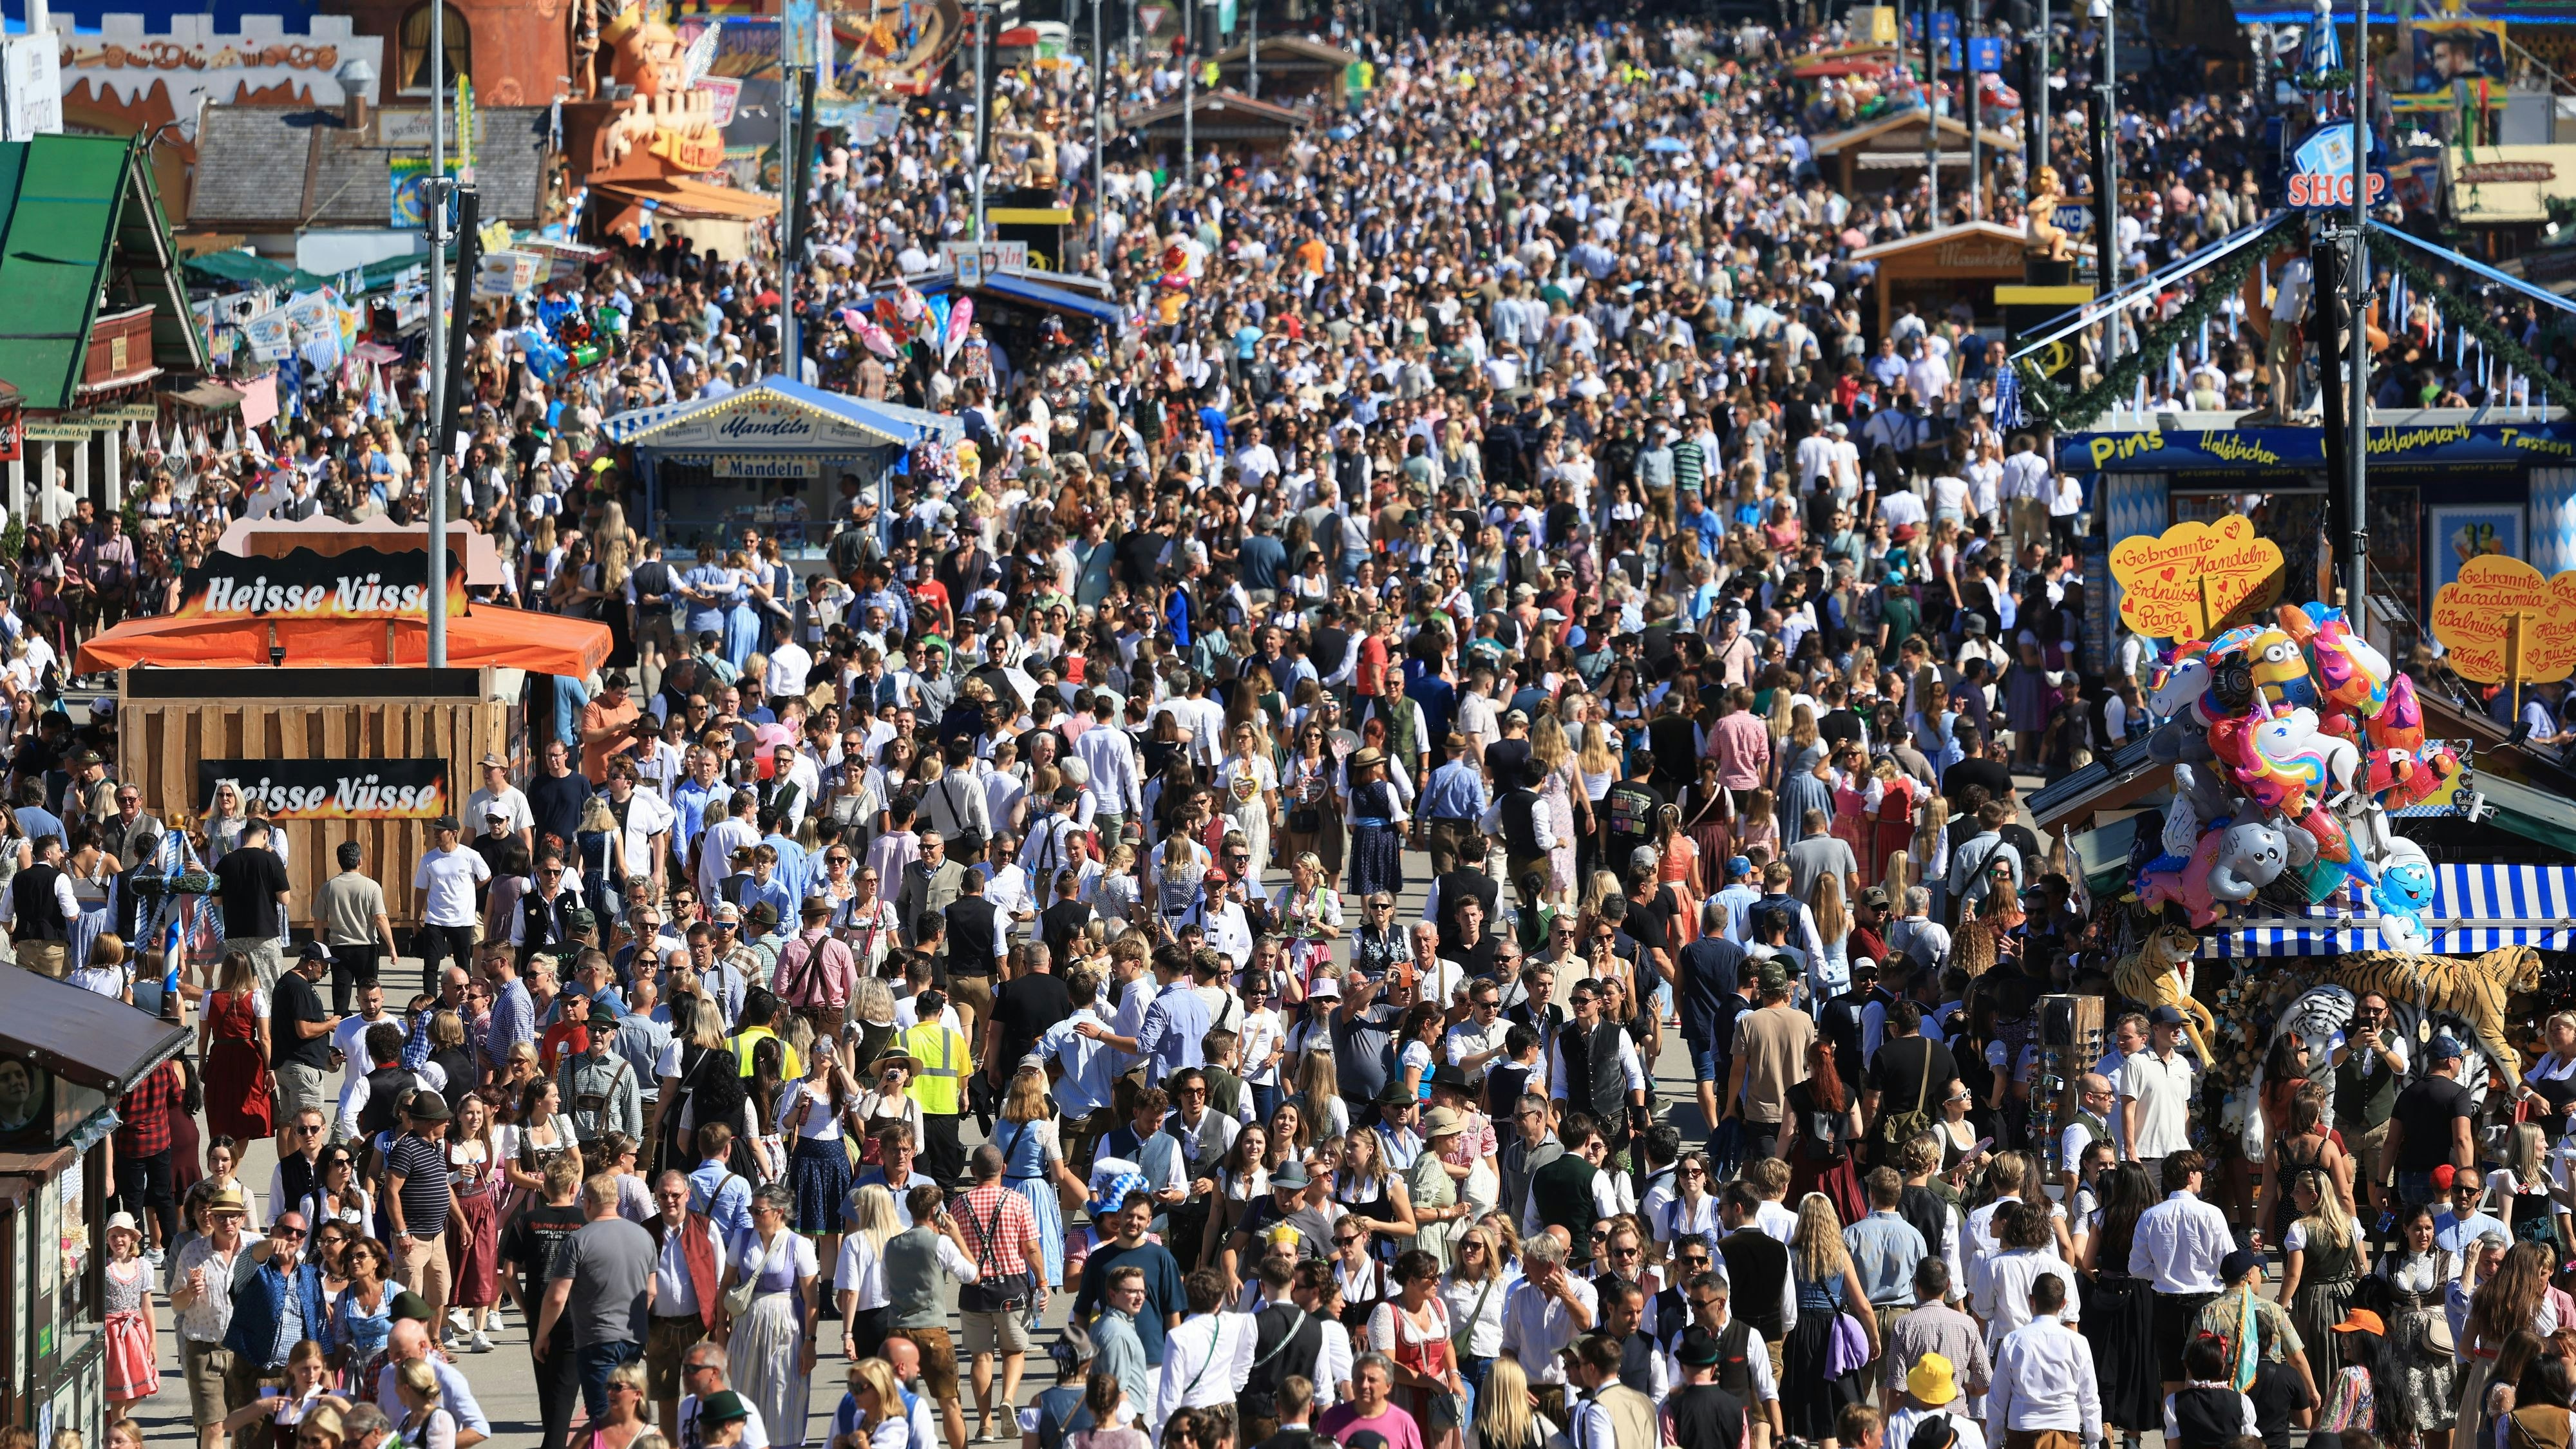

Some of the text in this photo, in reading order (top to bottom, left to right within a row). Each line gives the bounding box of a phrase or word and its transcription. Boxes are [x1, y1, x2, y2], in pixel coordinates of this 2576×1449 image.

[2288, 173, 2385, 207] SHOP
[2052, 211, 2080, 227] WC
[720, 415, 811, 439] Mandeln
[830, 426, 862, 439] Popcorn
[2089, 430, 2165, 470] Pins
[2199, 430, 2280, 466] Halstücher
[2501, 428, 2572, 456] Tassen
[729, 460, 804, 477] Mandeln
[2123, 536, 2214, 567] Gebrannte
[2189, 545, 2269, 575] Mandeln
[2131, 580, 2204, 603] Erdnüsse
[2463, 567, 2541, 591] Gebrannte
[204, 573, 326, 614] Heisse
[2215, 575, 2272, 616] Cashew
[2443, 587, 2546, 609] Macadamia
[2139, 605, 2188, 629] Para
[2438, 609, 2514, 639] Walnüsse
[2452, 646, 2505, 674] Kürbis
[332, 773, 437, 812] Nüsse
